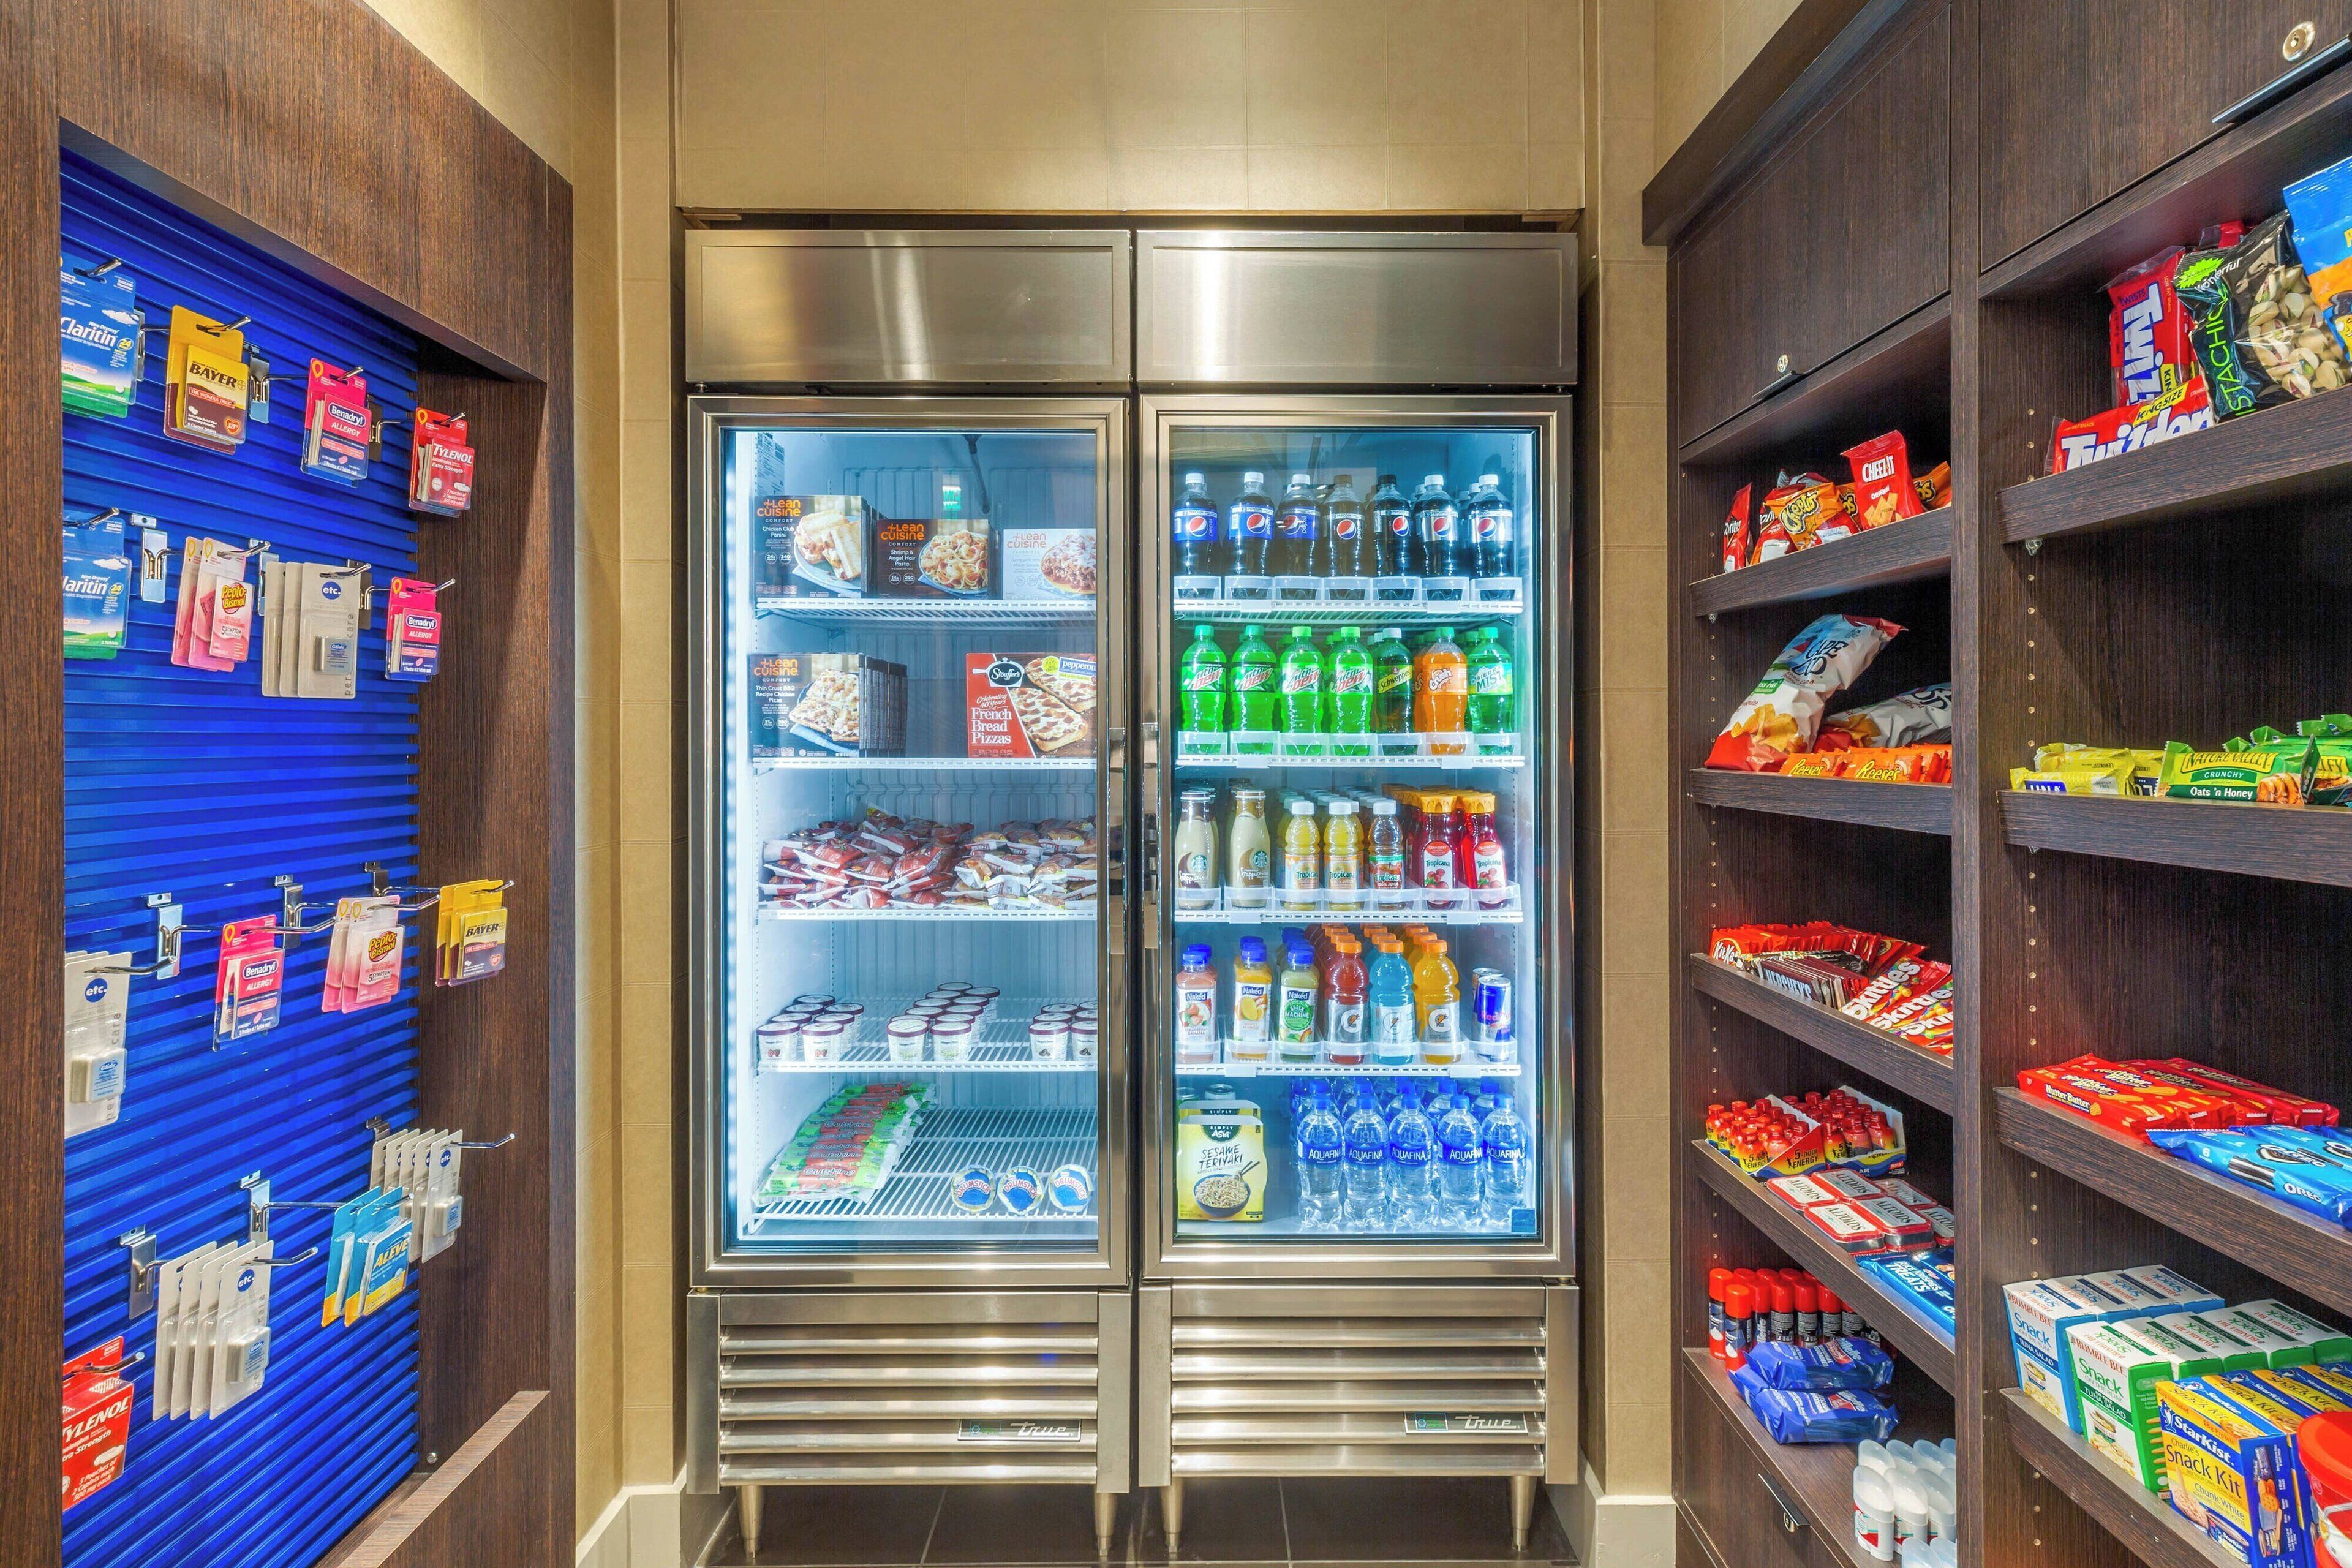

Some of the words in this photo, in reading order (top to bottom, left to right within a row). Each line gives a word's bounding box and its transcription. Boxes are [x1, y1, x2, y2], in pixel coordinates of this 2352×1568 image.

[2195, 257, 2241, 292] Wonderful
[61, 317, 118, 347] Claritin
[189, 363, 237, 388] BAYER
[2162, 390, 2184, 409] SIZE
[331, 405, 363, 425] Benadryl
[331, 422, 361, 437] ALLERGY
[433, 443, 472, 464] TYLENOL
[444, 465, 464, 474] Strength
[772, 499, 801, 508] Lean
[897, 523, 924, 532] Lean
[222, 584, 246, 598] Pepto-
[322, 586, 341, 594] etc.
[223, 595, 246, 609] Bismol
[408, 617, 435, 628] Benadryl
[769, 658, 798, 667] Lean
[991, 668, 1020, 680] Stouffer's
[976, 694, 1008, 704] Celebrating
[989, 700, 1006, 709] Years
[971, 708, 1012, 720] French
[971, 720, 1008, 732] Bread
[971, 732, 1011, 744] Pizzas
[2185, 753, 2231, 769] NATURE
[2233, 753, 2271, 770] VALLEY
[2190, 787, 2211, 796] Oats
[2214, 788, 2221, 796] 'n
[2224, 787, 2253, 799] Honey
[466, 923, 499, 937] BAYER
[369, 932, 398, 951] Pepto-
[370, 943, 396, 960] Bismol
[246, 963, 276, 977] Benadryl
[86, 986, 108, 997] etc.
[246, 978, 274, 991] ALLERGY
[2045, 1084, 2068, 1101] Nutter
[2067, 1092, 2090, 1109] Butter
[1202, 1144, 1240, 1159] SESAME
[1349, 1148, 1383, 1161] AQUAFINA
[1392, 1147, 1426, 1161] AQUAFINA
[1795, 1149, 1818, 1159] 5-hour
[2258, 1144, 2326, 1167] OREO
[1199, 1154, 1243, 1170] TERIYAKI
[1793, 1156, 1819, 1168] ENERGY
[956, 1179, 991, 1197] DRUMSTICK
[1003, 1178, 1037, 1198] DRUMSTICK
[1054, 1177, 1087, 1199] DRUMSTICK
[1789, 1179, 1823, 1200] ALTOIDS
[1837, 1172, 1870, 1194] ALTOIDS
[2284, 1182, 2322, 1202] OREO
[1826, 1207, 1865, 1231] ALTOIDS
[1873, 1200, 1915, 1224] ALTOIDS
[374, 1238, 408, 1270] ALEVE
[238, 1275, 255, 1288] etc.
[1885, 1262, 1931, 1292] TREATS
[2011, 1295, 2038, 1317] BUMBLE
[2040, 1314, 2051, 1327] BEE
[2015, 1313, 2052, 1347] Snack
[2018, 1338, 2035, 1354] TUNA
[2035, 1348, 2054, 1365] SALAD
[2076, 1339, 2107, 1365] BUMBLE
[2109, 1359, 2124, 1374] BEE
[2079, 1357, 2124, 1398] Snack
[2271, 1377, 2307, 1396] Snack
[2084, 1387, 2103, 1404] TUNA
[2104, 1401, 2126, 1419] SALAD
[75, 1430, 111, 1455] Strength
[2171, 1438, 2199, 1456] Charlie's
[2174, 1415, 2231, 1463] StarKist
[2166, 1445, 2212, 1480] Snack
[2215, 1466, 2242, 1499] Kit
[2195, 1483, 2218, 1501] Chunk
[2220, 1497, 2245, 1519] White
